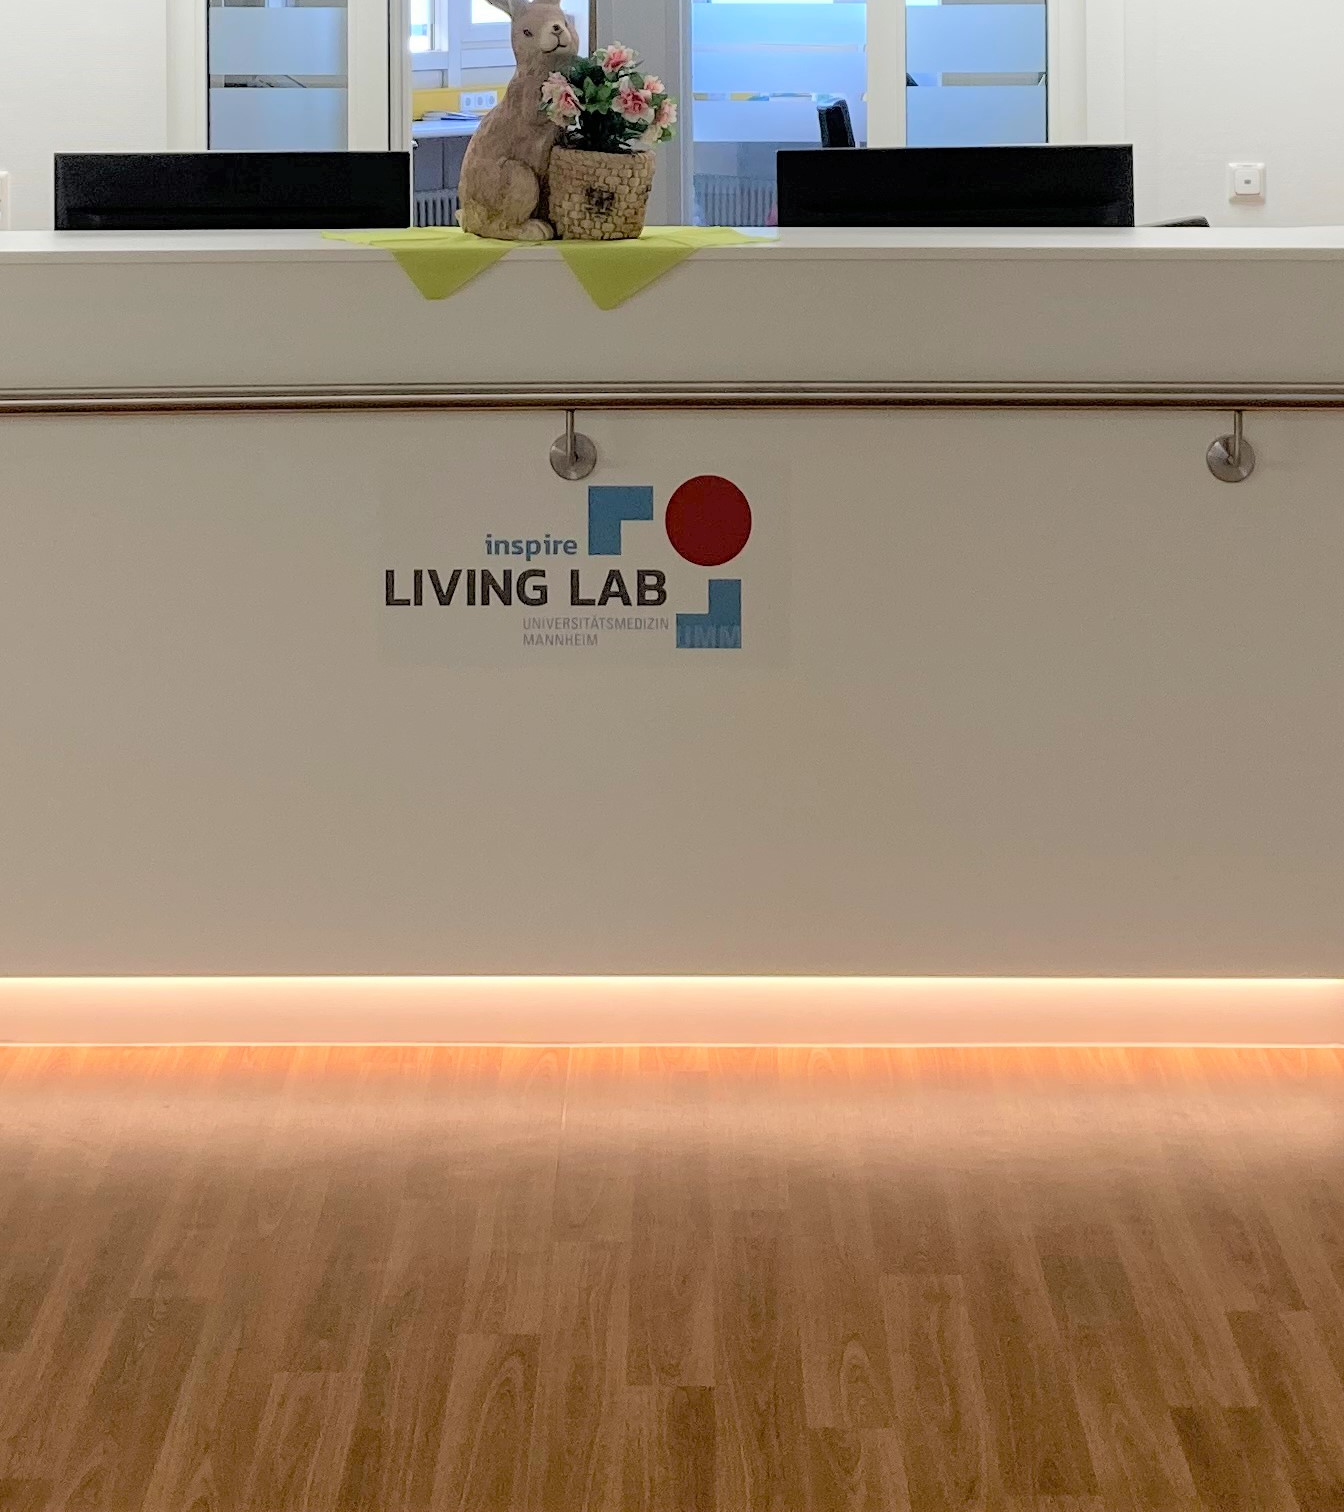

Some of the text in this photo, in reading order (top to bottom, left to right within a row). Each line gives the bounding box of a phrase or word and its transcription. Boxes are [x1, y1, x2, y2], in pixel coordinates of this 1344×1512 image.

[485, 533, 578, 562] inspire
[384, 569, 668, 607] LIVING LAB
[522, 614, 669, 631] UNIVERSITÄTSMEDIZIN
[522, 633, 599, 647] MANNHEIM
